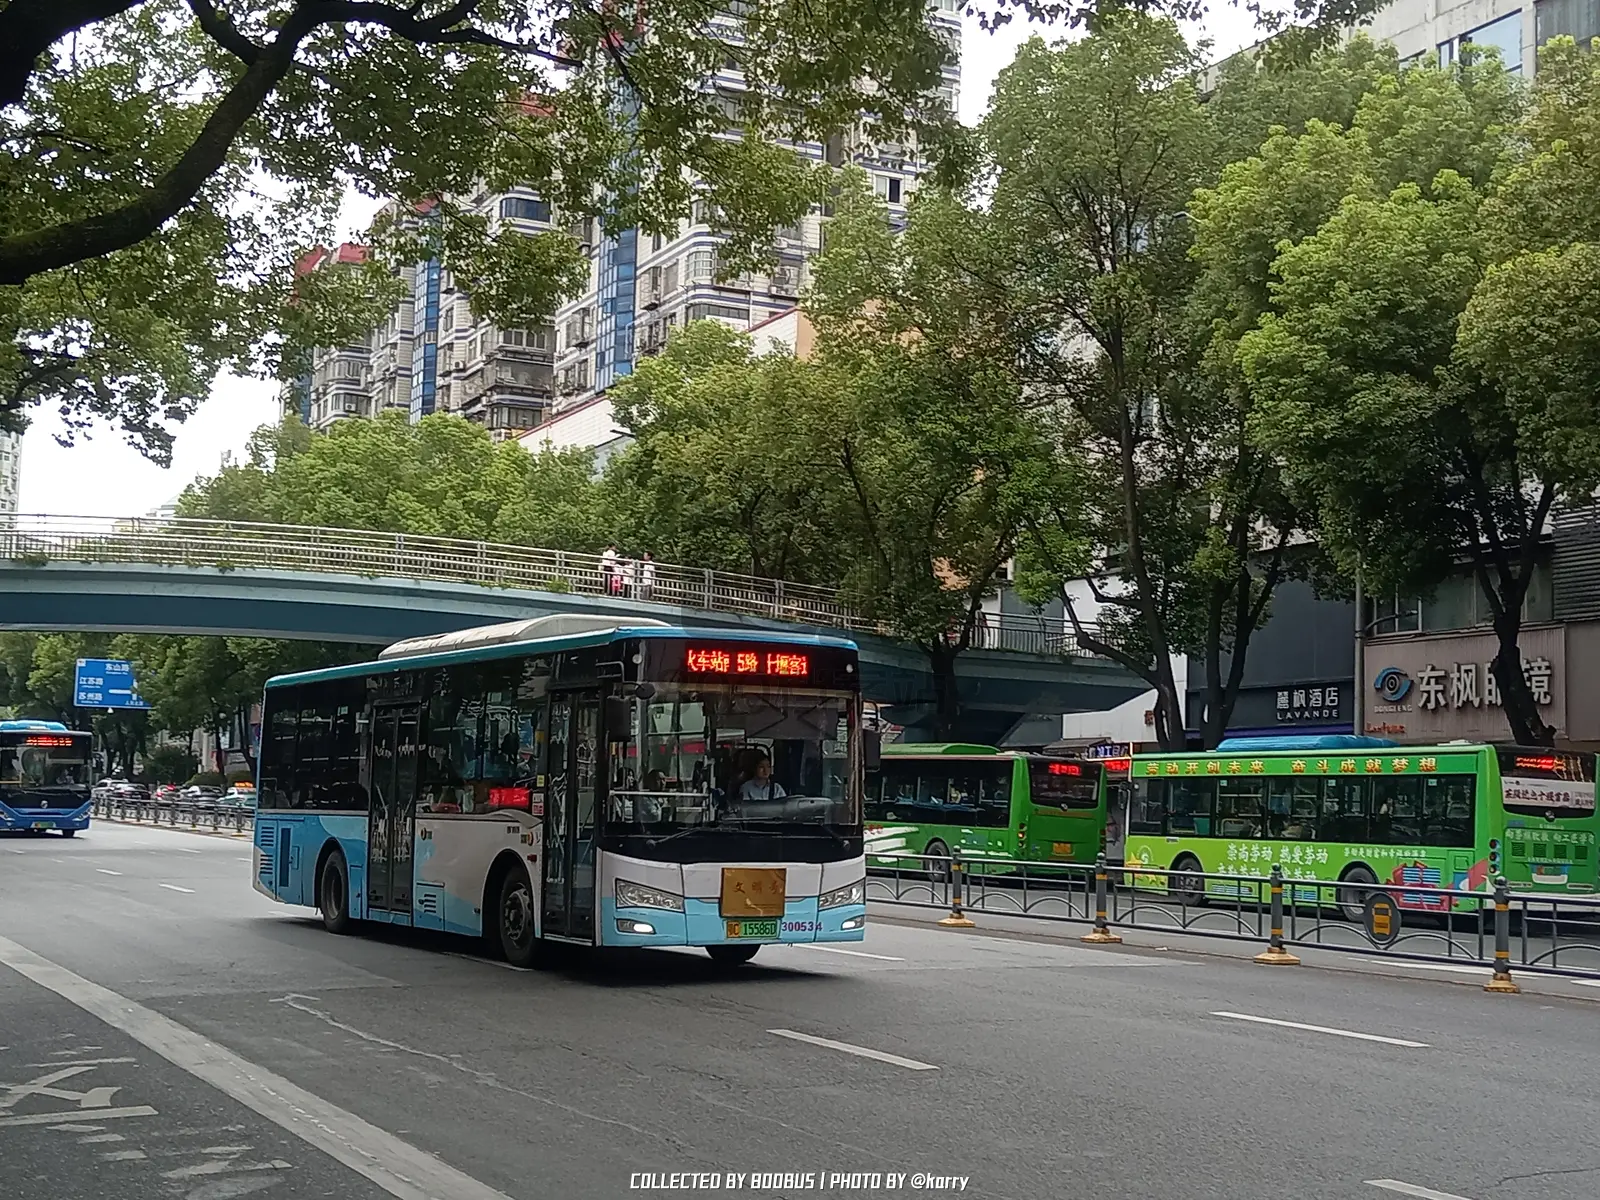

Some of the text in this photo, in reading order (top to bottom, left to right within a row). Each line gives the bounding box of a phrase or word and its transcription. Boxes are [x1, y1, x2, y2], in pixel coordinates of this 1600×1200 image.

[1276, 709, 1338, 721] LAVANDE
[1145, 760, 1265, 776] 劳动开创未来
[1290, 756, 1438, 774] 奋斗成就梦想
[1226, 842, 1329, 866] 崇尚劳动 热爱劳动
[781, 921, 823, 932] 300534
